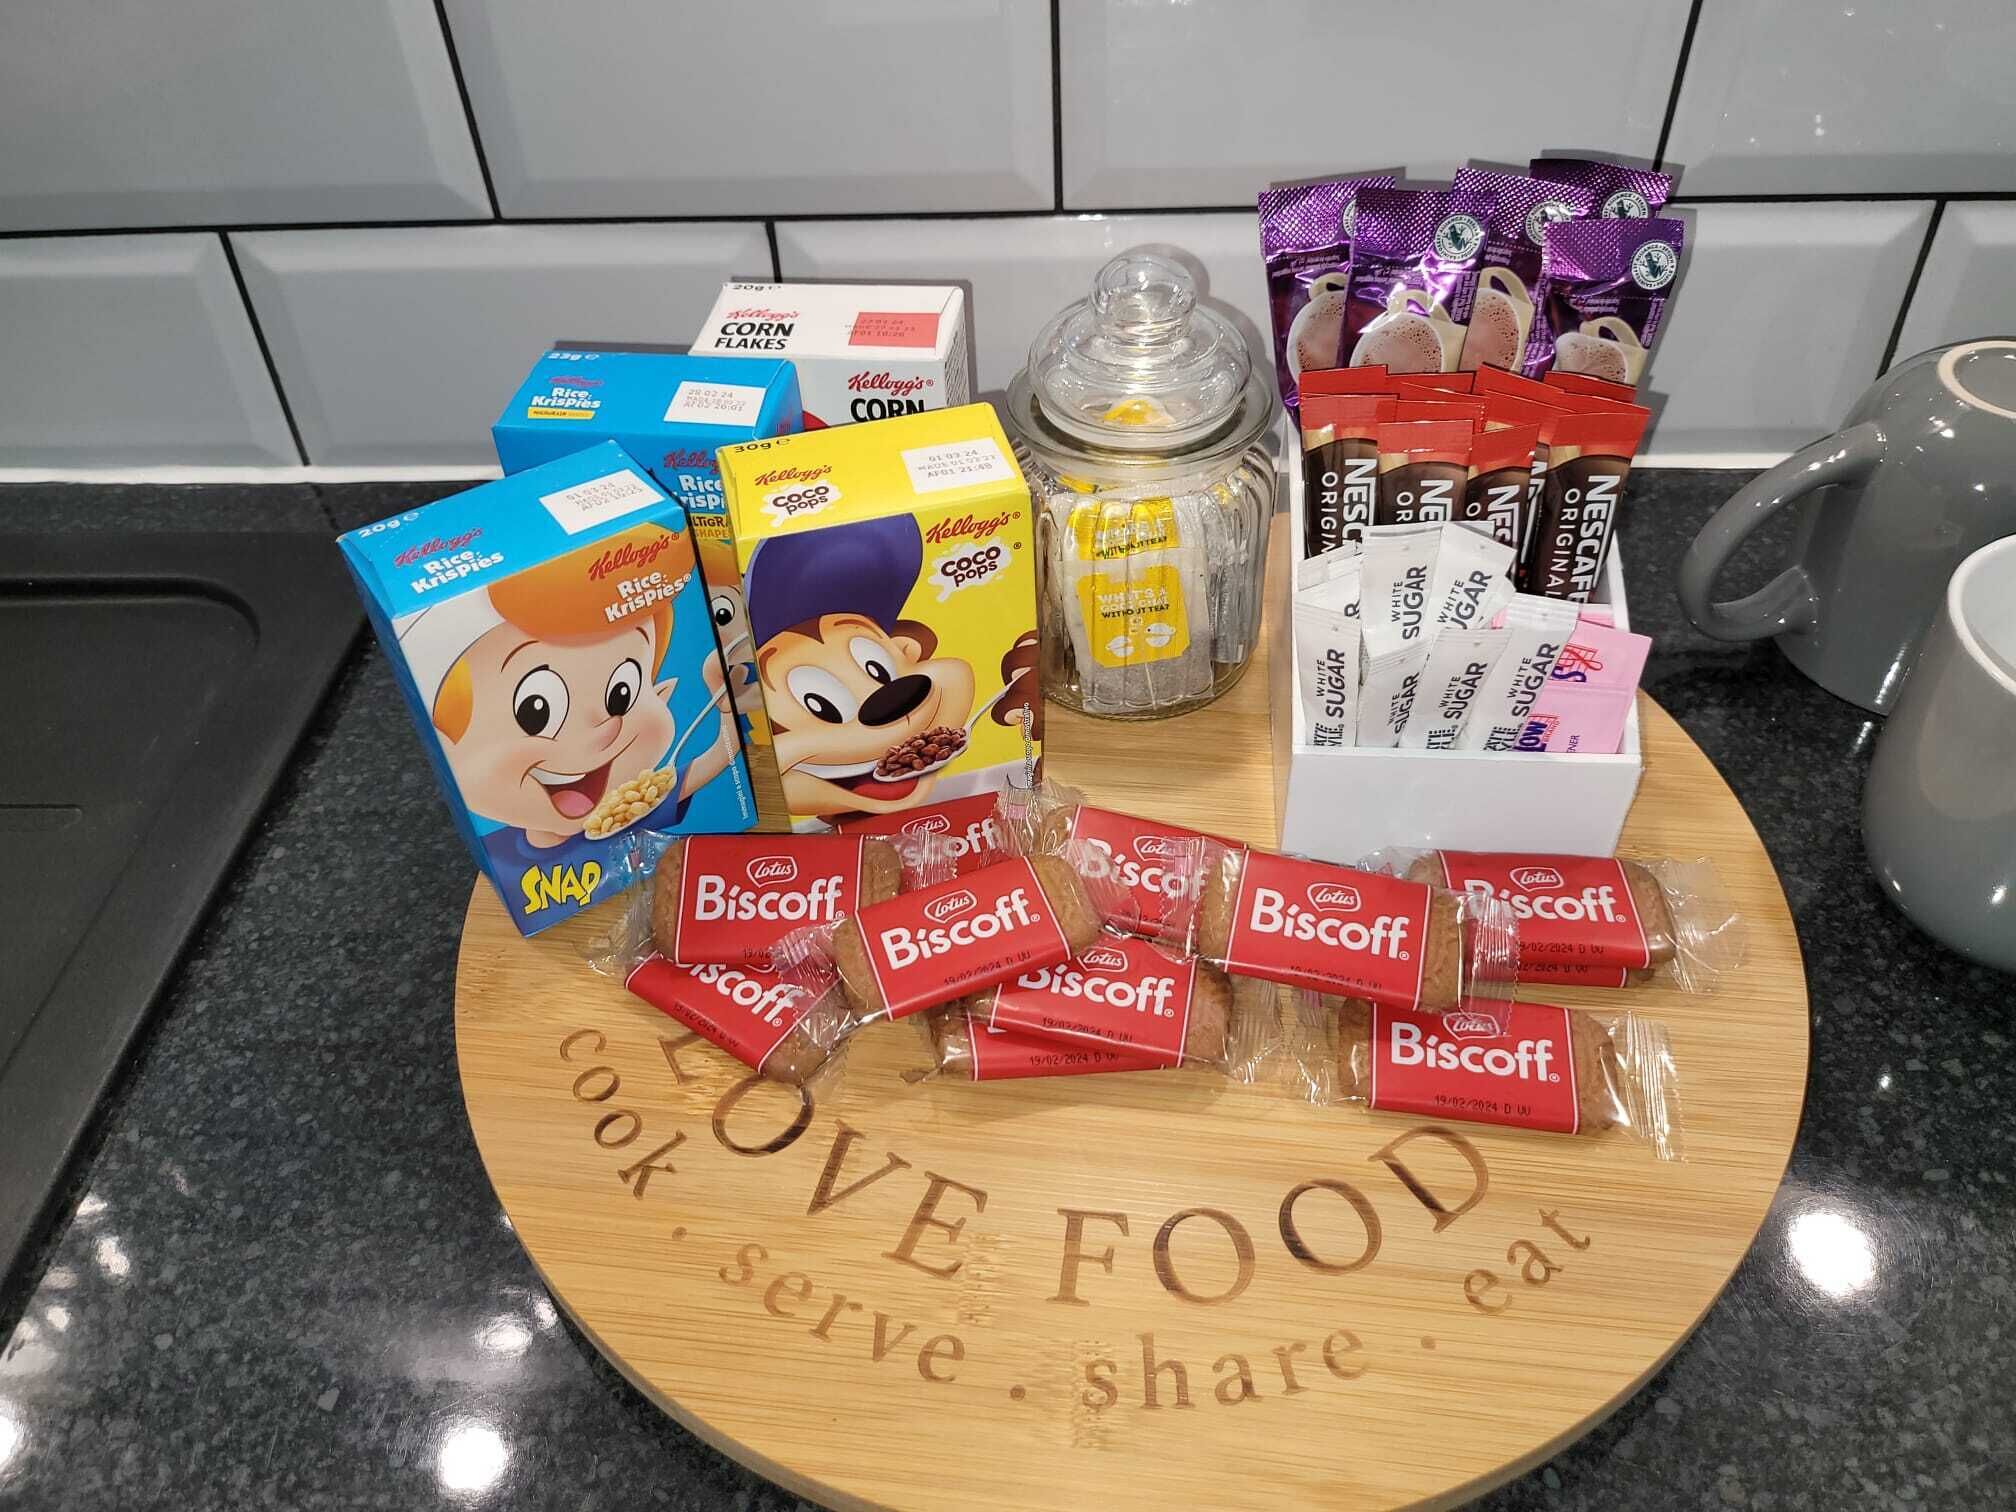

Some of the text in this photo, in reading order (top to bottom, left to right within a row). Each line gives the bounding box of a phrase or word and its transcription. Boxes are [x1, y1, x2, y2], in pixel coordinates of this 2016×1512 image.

[726, 309, 800, 321] Kellogg's
[720, 322, 794, 337] CORN
[714, 337, 787, 350] FLAKES
[552, 387, 589, 397] Rice
[848, 371, 924, 397] Kellogg's
[531, 396, 601, 409] Krispies
[850, 398, 924, 423] CORN
[734, 441, 771, 454] 30g
[965, 449, 979, 457] 24
[754, 464, 832, 486] Kellogg's
[786, 494, 829, 516] pops
[359, 519, 401, 538] 20g
[926, 511, 1010, 544] Kellogg's
[394, 528, 484, 567] Kellogg's
[589, 538, 670, 581] Kellogg's
[410, 552, 504, 594] Krispies
[423, 551, 474, 574] Rice
[953, 562, 998, 588] pops
[616, 572, 662, 599] Rice
[604, 580, 685, 623] Krispies
[1101, 604, 1170, 619] WITHOUT TEA?
[1392, 581, 1403, 622] WHITE
[1402, 565, 1428, 640] SUGAR
[1437, 580, 1464, 624] WHITE
[1450, 570, 1492, 630] UGAR
[1316, 659, 1326, 697] WHITE
[1326, 649, 1345, 719] SUGAR
[1443, 662, 1488, 720] SUGAR
[1507, 657, 1532, 698] WHITE
[1512, 643, 1560, 717] SUGAR
[1394, 671, 1420, 734] SUGAR
[1438, 675, 1461, 708] WHITE
[1387, 692, 1400, 726] WHITE
[754, 859, 794, 879] Lotus
[1519, 869, 1558, 887] Lotus
[520, 861, 602, 915] SNAP
[696, 875, 844, 922] Biscoff
[1316, 888, 1357, 908] Lotus
[1463, 879, 1615, 923] Biscoff
[935, 895, 972, 917] Lotus
[881, 888, 1029, 971] Biscoff
[1249, 887, 1410, 959] Biscoff
[1083, 950, 1123, 968] Lotus
[1518, 942, 1574, 954] 9/02/2024
[944, 960, 1001, 985] 19/02/2024
[677, 963, 804, 1024] iscoff
[1042, 1017, 1102, 1036] 19/02/2024
[1452, 1016, 1492, 1032] Lotus
[1030, 1055, 1088, 1066] 19/02/2024
[1391, 1021, 1554, 1082] Biscoff
[1434, 1094, 1498, 1112] 19/02/2024
[1504, 1102, 1511, 1114] D
[560, 1028, 1593, 1412] cook serve share eat
[1049, 1125, 1490, 1307] FOOD
